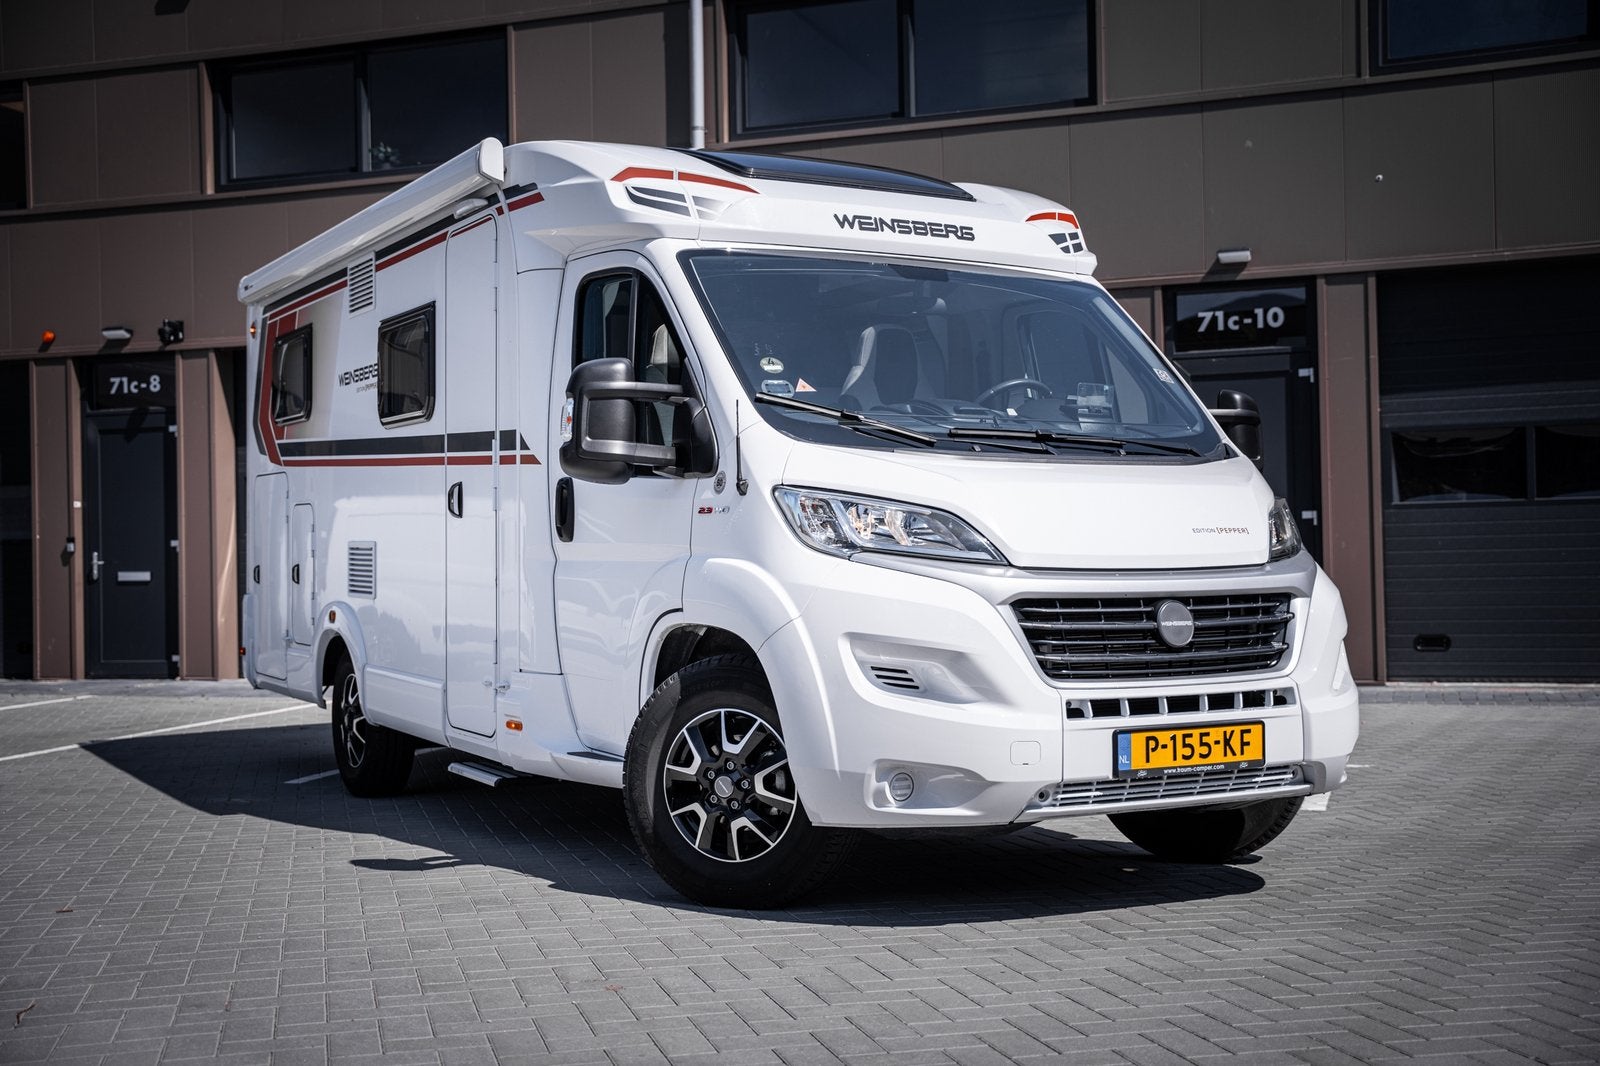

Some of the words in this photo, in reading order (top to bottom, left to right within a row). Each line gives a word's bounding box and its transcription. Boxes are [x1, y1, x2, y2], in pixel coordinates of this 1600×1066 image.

[834, 213, 975, 241] WEINSBERG
[1197, 307, 1285, 333] 71c-10
[110, 374, 161, 395] 71c-8
[338, 362, 378, 387] WEINSBERG
[1145, 728, 1252, 763] P-155-KF
[1119, 755, 1130, 764] NL
